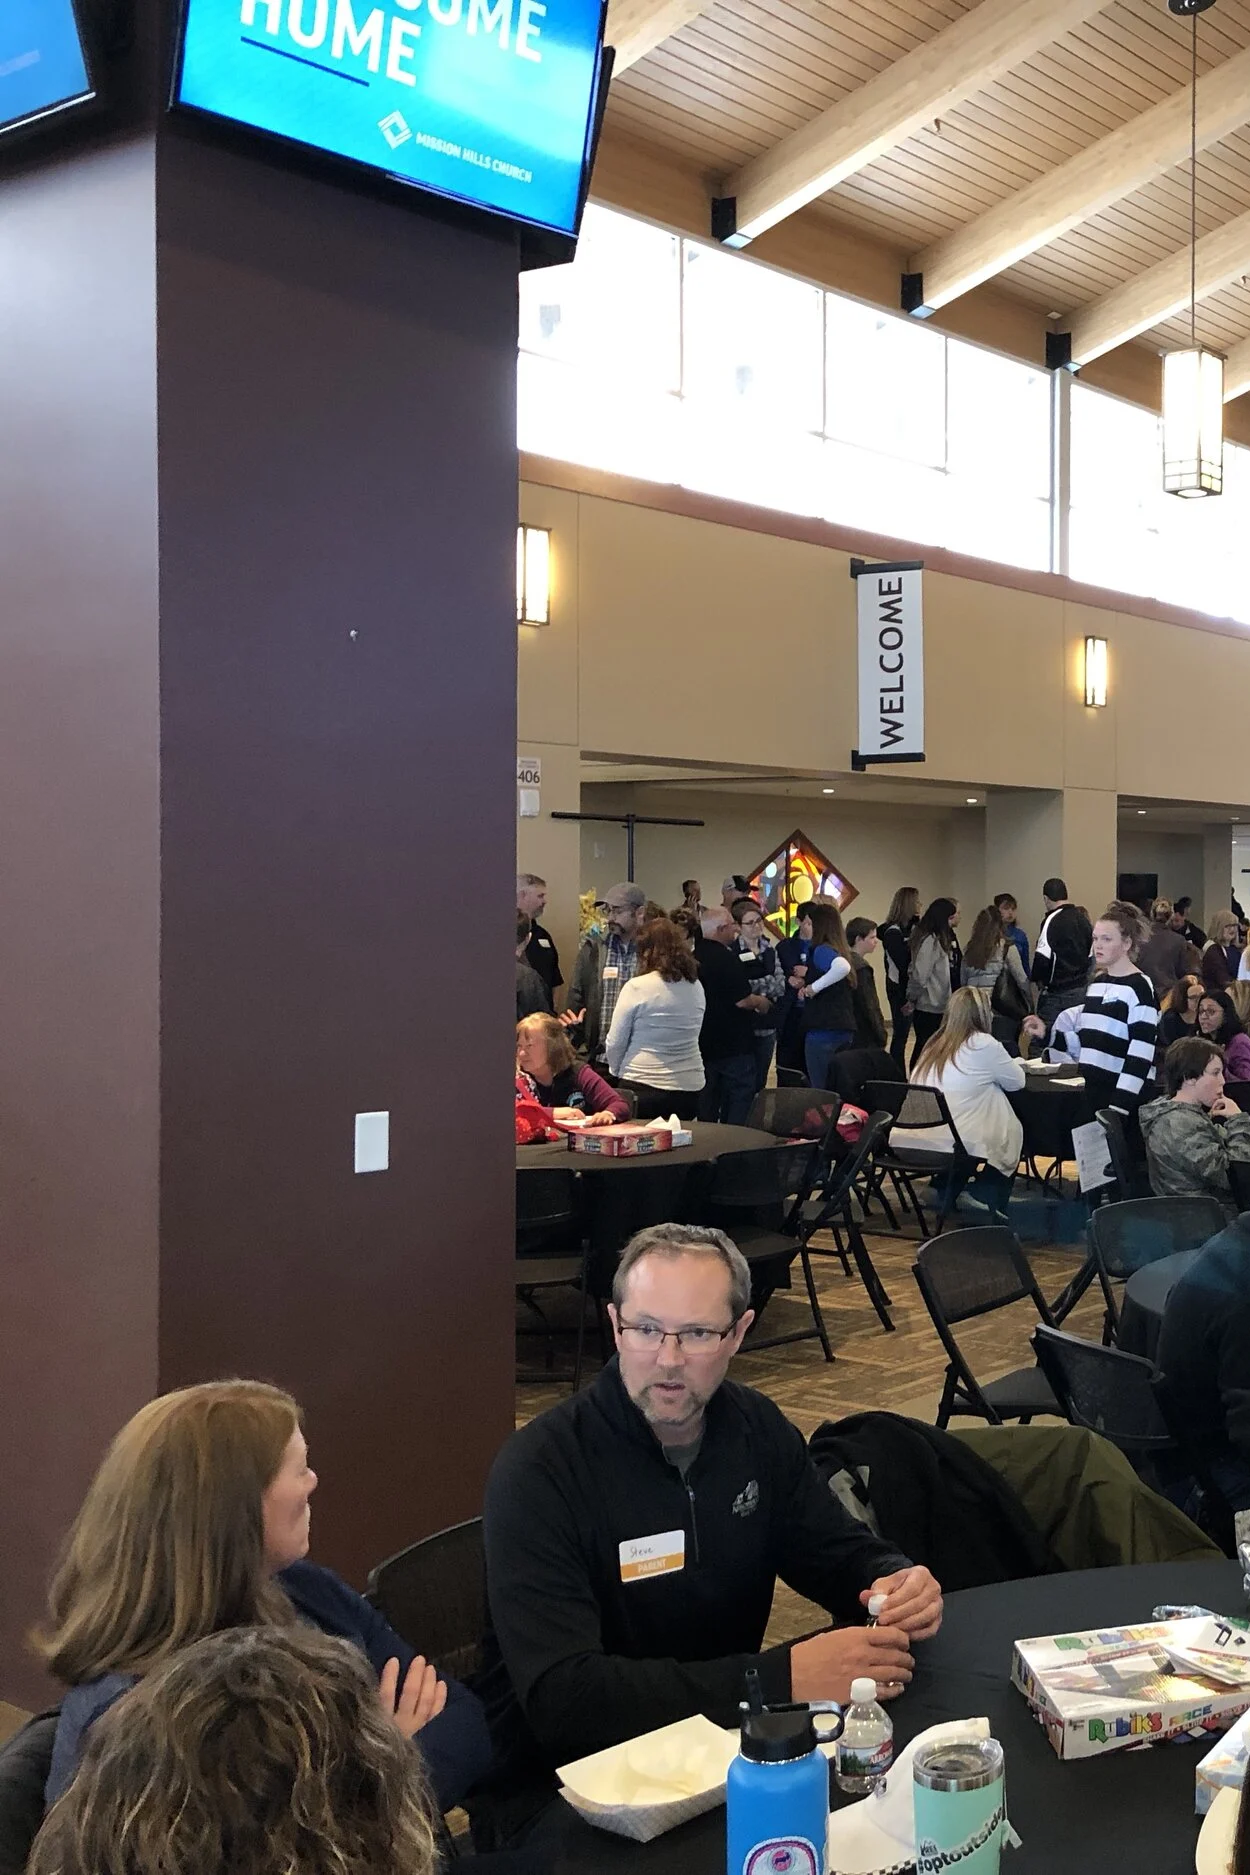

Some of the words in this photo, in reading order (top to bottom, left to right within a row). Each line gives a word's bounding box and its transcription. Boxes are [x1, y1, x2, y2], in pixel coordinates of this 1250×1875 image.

[415, 131, 462, 158] MISSION
[462, 148, 492, 170] HILLS
[491, 159, 534, 184] CHURCH
[878, 576, 905, 750] WELCOME
[630, 1546, 654, 1559] Steve
